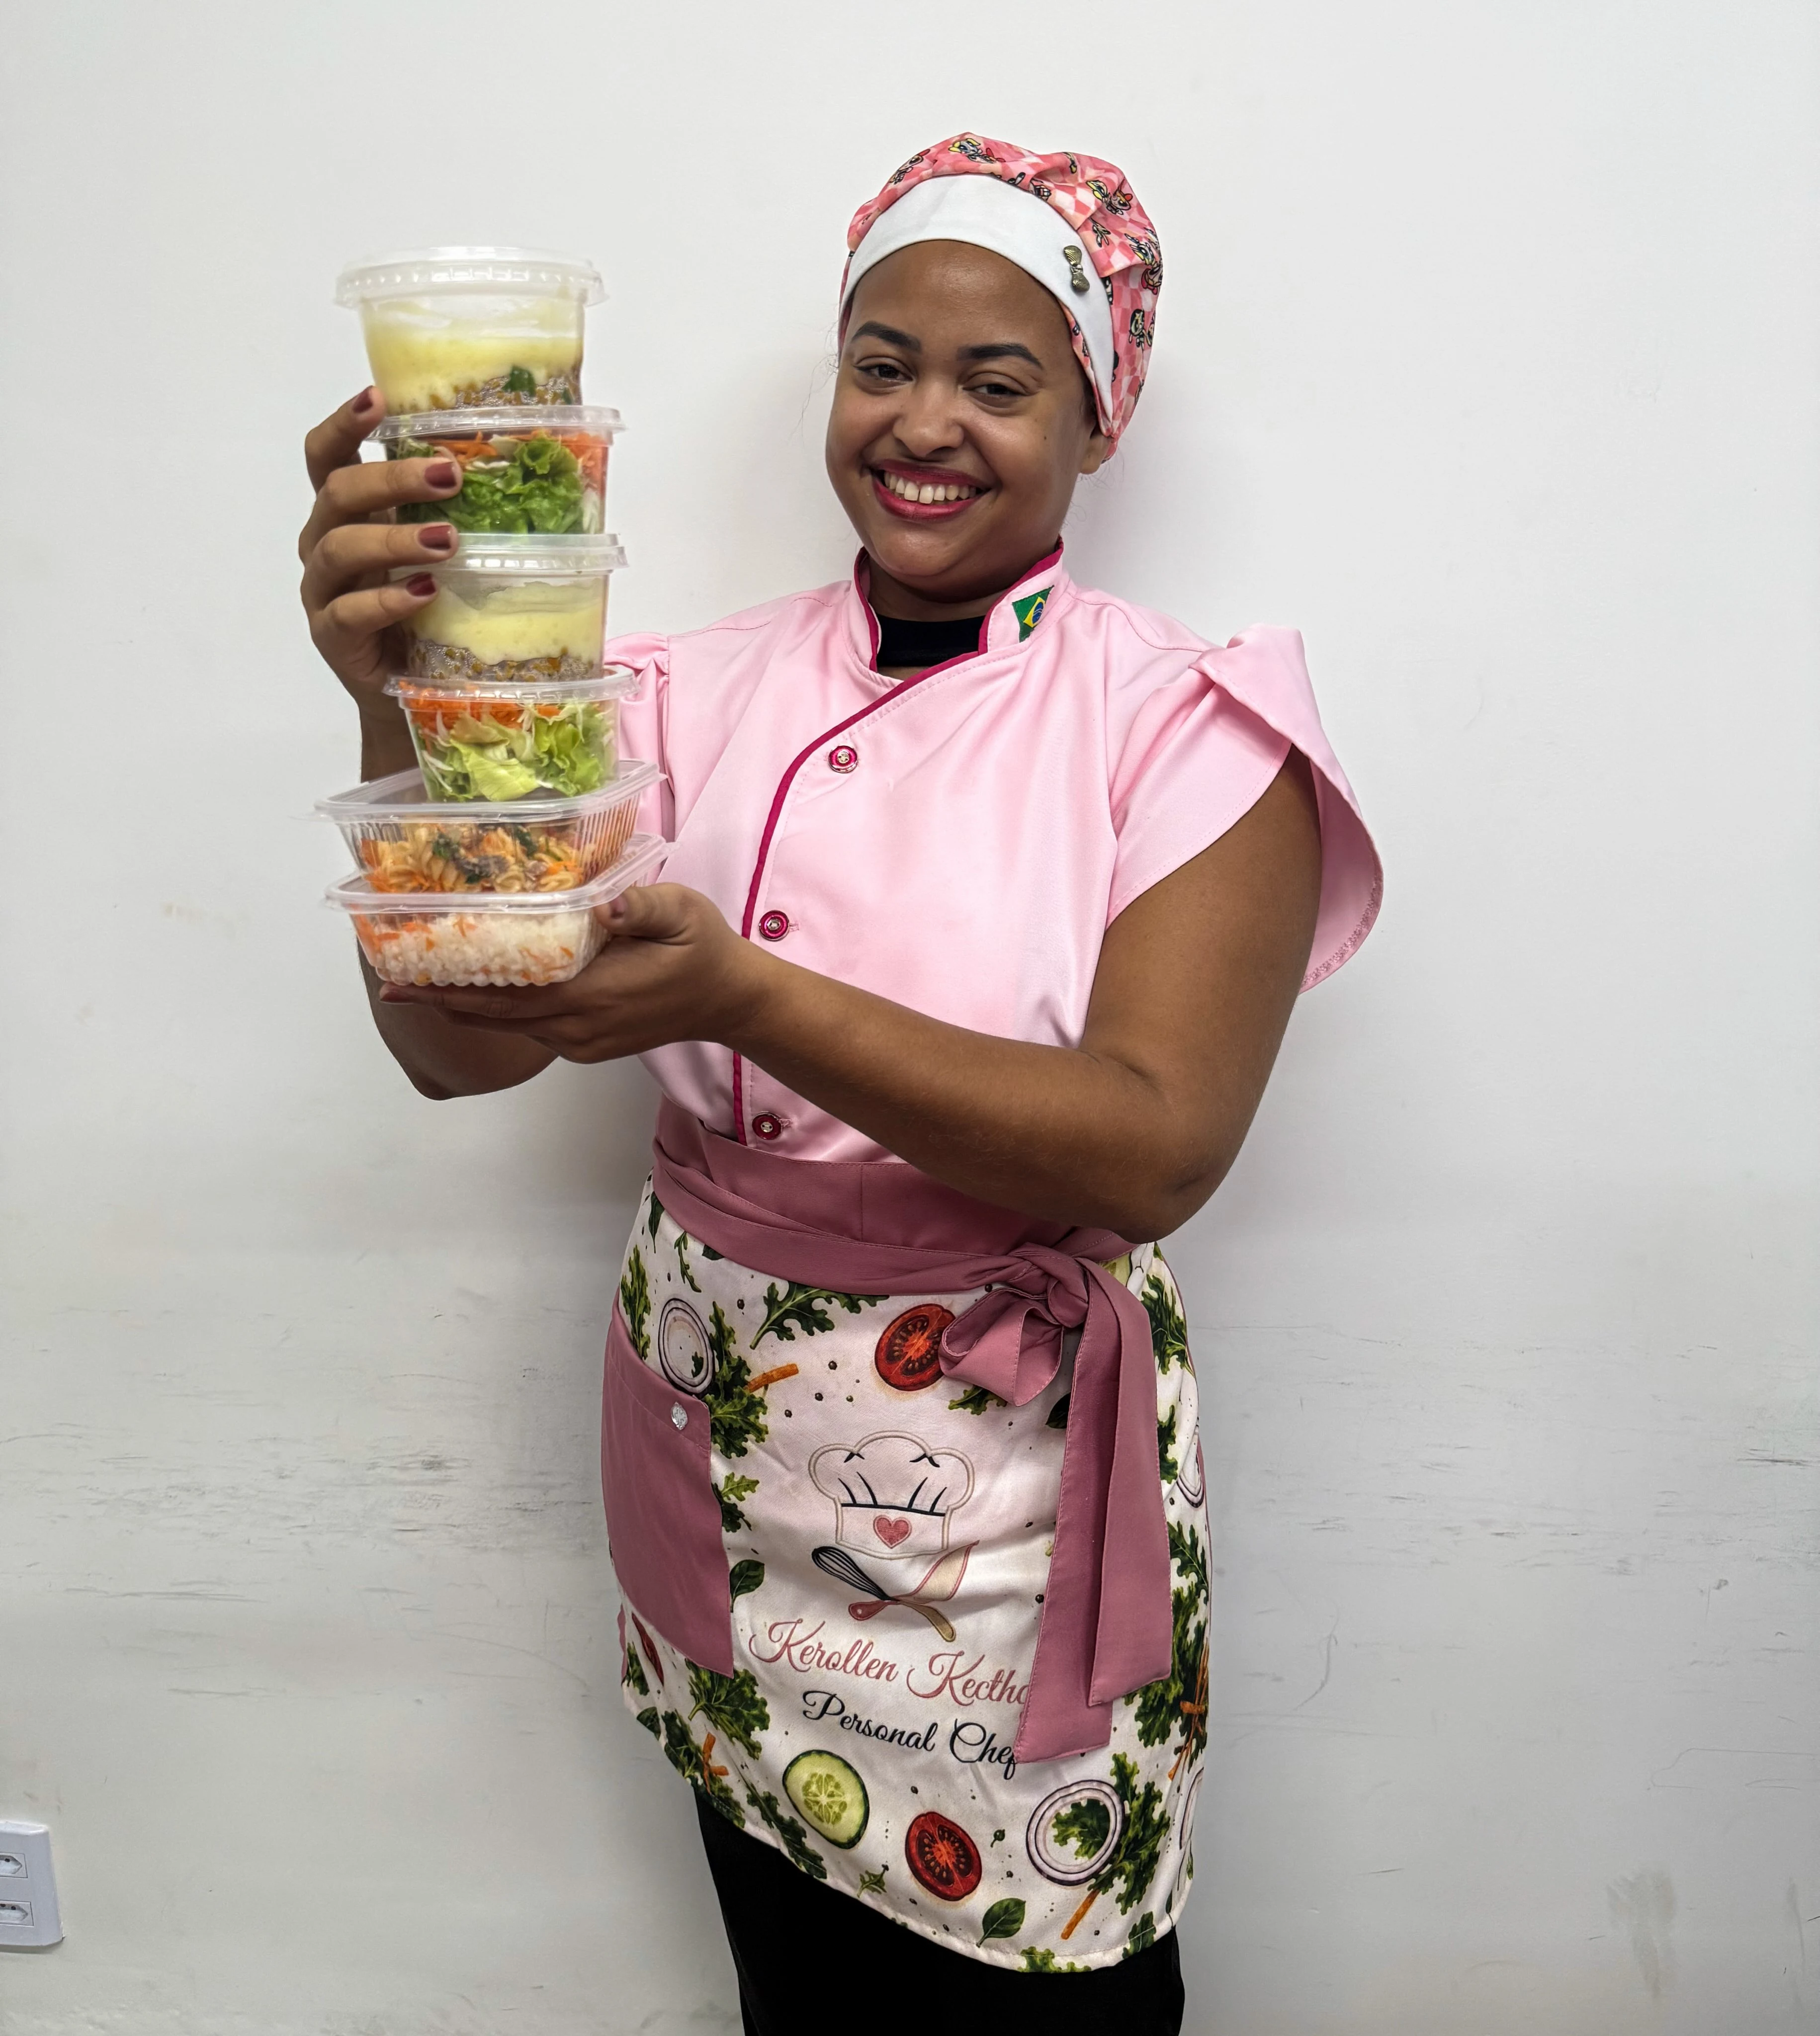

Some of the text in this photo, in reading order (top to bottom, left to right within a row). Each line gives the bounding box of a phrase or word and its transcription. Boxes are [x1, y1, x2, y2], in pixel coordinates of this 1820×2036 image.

[749, 1618, 899, 1682] Kerollen
[802, 1690, 1017, 1780] Personal Chef
